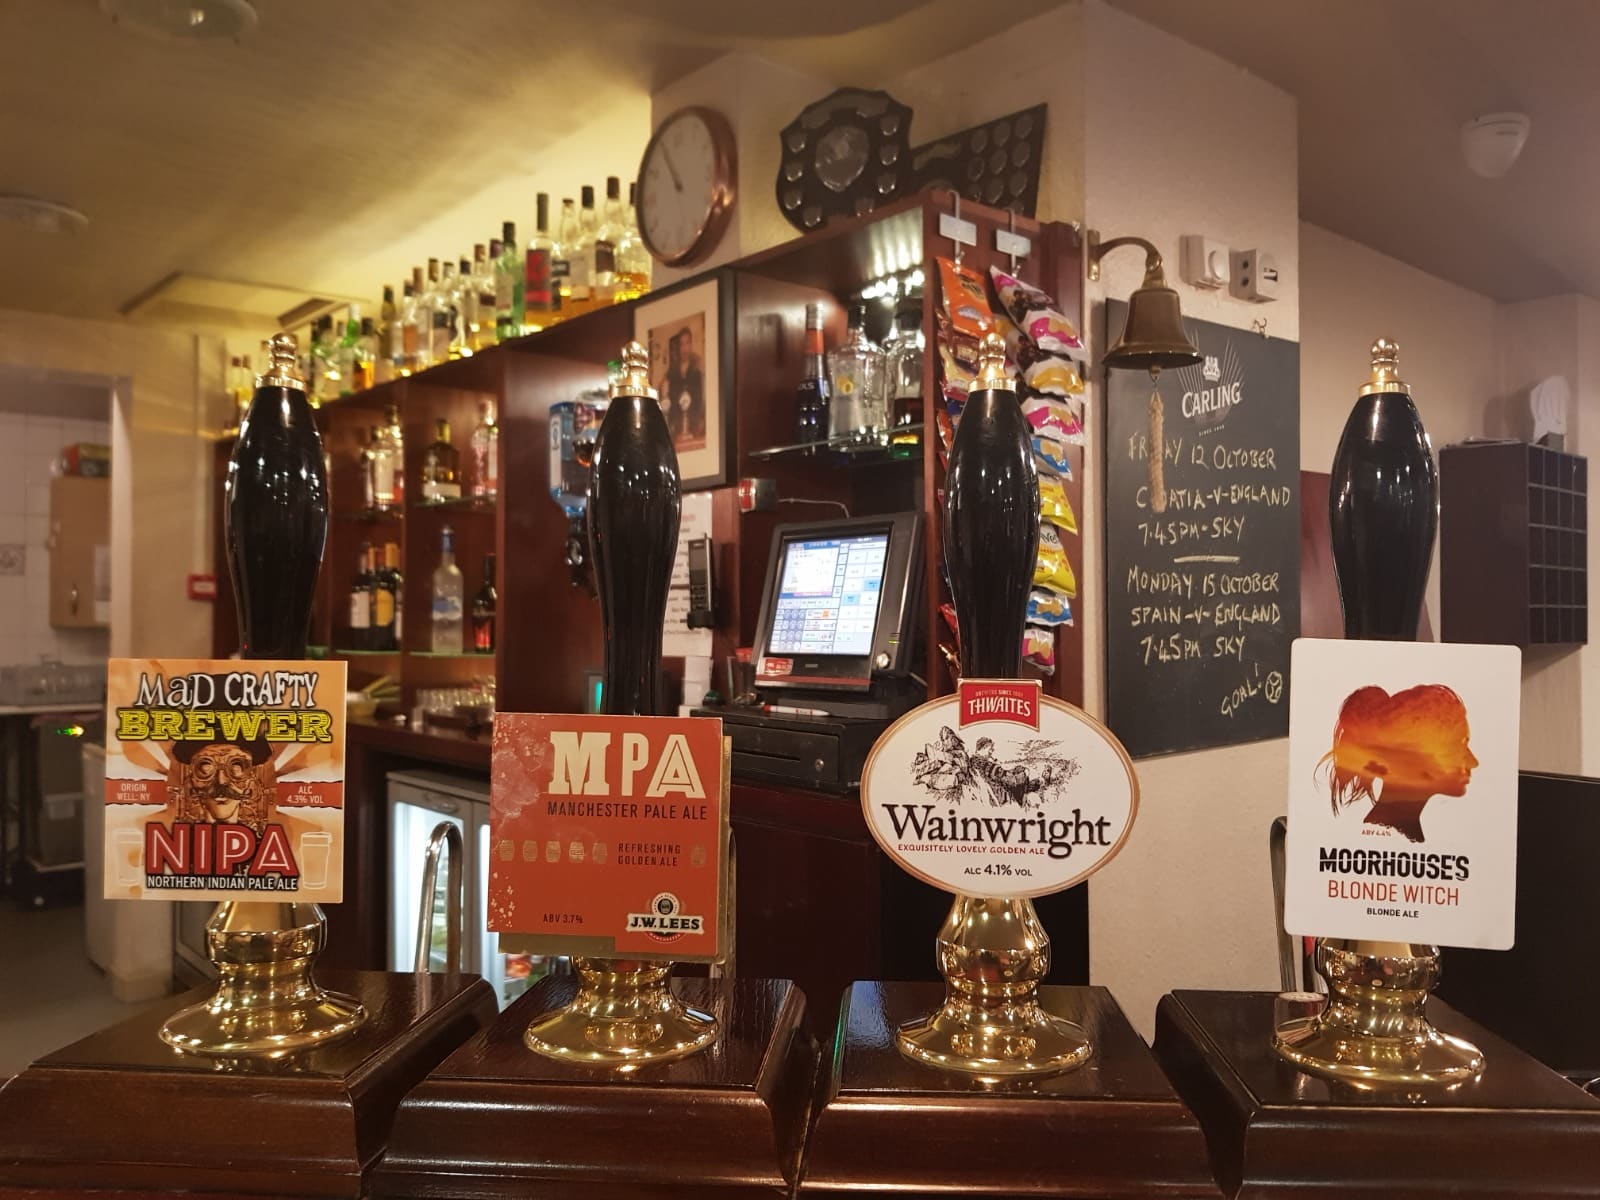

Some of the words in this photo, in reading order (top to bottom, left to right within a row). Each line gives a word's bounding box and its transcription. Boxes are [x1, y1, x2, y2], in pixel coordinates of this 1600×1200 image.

[1181, 382, 1241, 418] CARLING
[1128, 431, 1183, 467] FRAY
[1191, 445, 1209, 469] 12
[1127, 565, 1193, 600] MONDAY
[1203, 573, 1215, 597] 15
[1220, 571, 1280, 595] OCTOBER
[1214, 634, 1246, 662] SKY
[224, 673, 318, 707] CRAFTY
[967, 695, 1031, 717] THWAITES
[116, 709, 333, 743] BREWER
[549, 731, 706, 799] MPA
[121, 783, 147, 792] ORIGIN
[298, 785, 313, 794] ALC
[309, 795, 324, 804] VOL
[547, 801, 637, 818] MANCHESTER
[644, 804, 677, 819] PALE
[682, 805, 708, 820] ALE
[882, 803, 1111, 860] Wainwright
[145, 823, 299, 876] NIPA
[618, 843, 681, 855] REFRESHING
[898, 844, 953, 853] EXQUISITELY
[956, 844, 987, 854] LOVELY
[989, 846, 1026, 855] GOLDEN
[1029, 847, 1045, 855] ALE
[618, 855, 656, 866] GOLDEN
[659, 856, 678, 867] ALE
[983, 864, 1012, 877] 4.1%
[1014, 869, 1032, 877] VOL
[1319, 847, 1469, 881] MOORHOUSE'S
[147, 876, 205, 889] NORTHERN
[207, 876, 245, 889] INDIAN
[248, 877, 275, 889] PALE
[276, 878, 298, 890] ALE
[1328, 880, 1398, 903] BLONDE
[1403, 884, 1459, 906] WITCH
[543, 913, 560, 923] ABV
[1366, 907, 1400, 917] BLONDE
[1402, 910, 1419, 918] ALE
